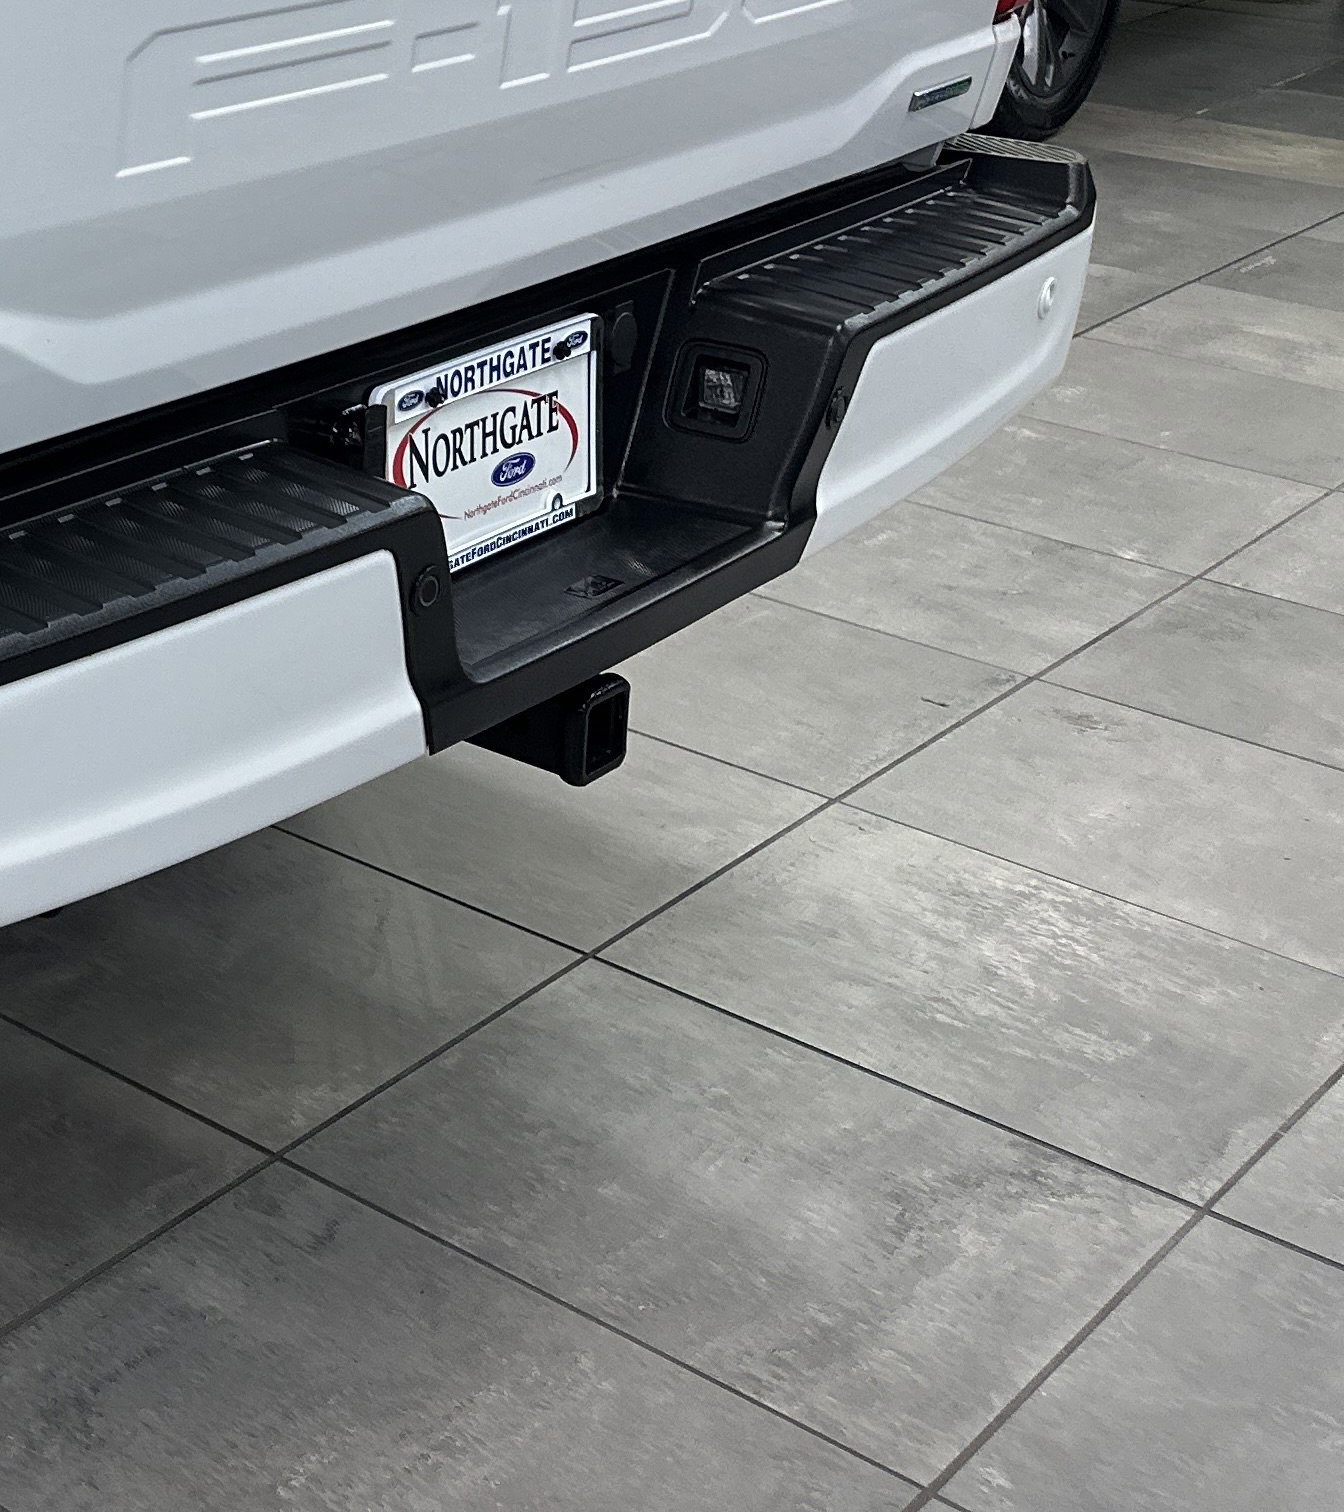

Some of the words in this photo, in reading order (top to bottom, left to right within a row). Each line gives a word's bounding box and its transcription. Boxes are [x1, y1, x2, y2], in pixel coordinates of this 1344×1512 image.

[436, 337, 552, 400] NORTHGATE
[408, 390, 560, 490] NORTHGATE
[499, 456, 528, 482] Ford
